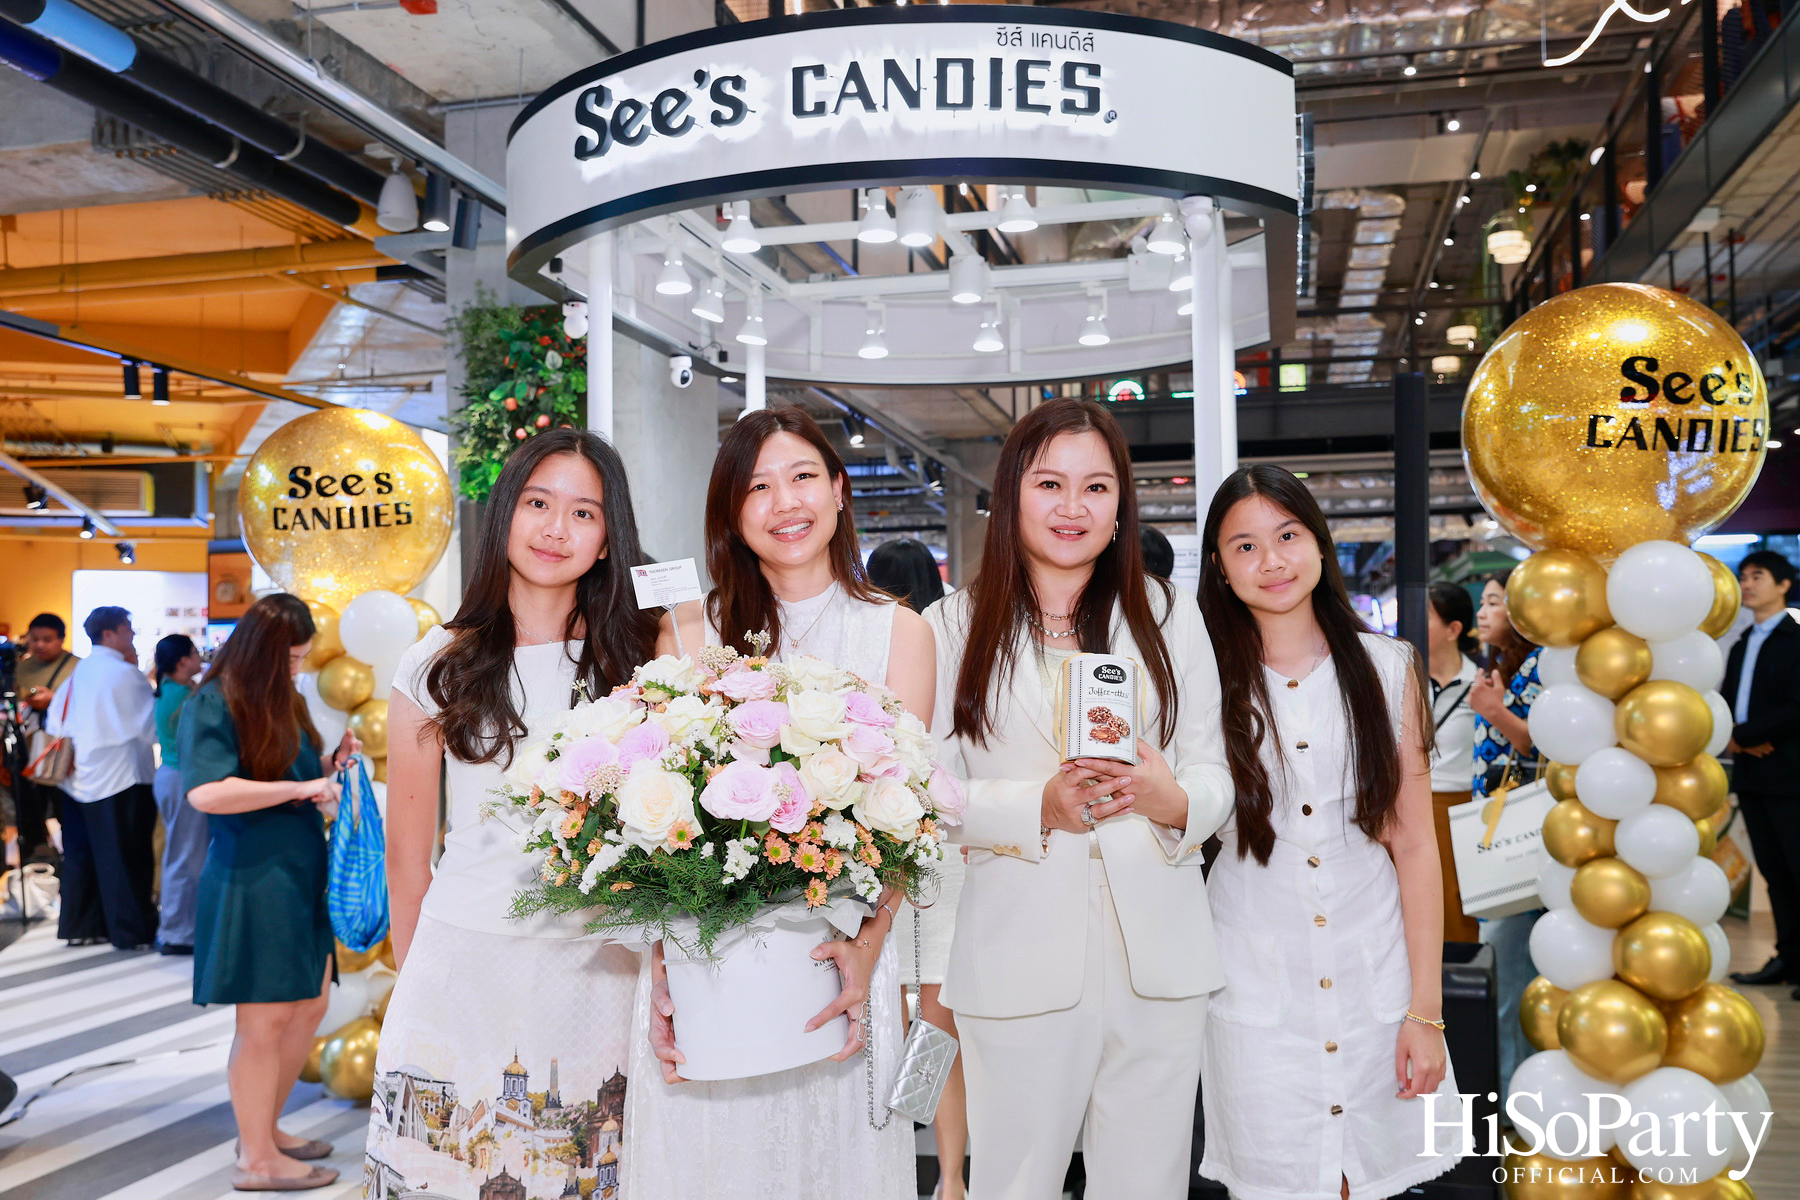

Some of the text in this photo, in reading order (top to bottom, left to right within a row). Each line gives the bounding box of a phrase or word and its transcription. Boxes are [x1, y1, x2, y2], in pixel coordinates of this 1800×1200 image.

[996, 26, 1095, 52] ซีส์ แคนดีส์
[574, 57, 1102, 161] See's CANDIES
[1620, 355, 1753, 406] See's
[273, 502, 412, 531] CANDIES
[1101, 666, 1121, 676] See's
